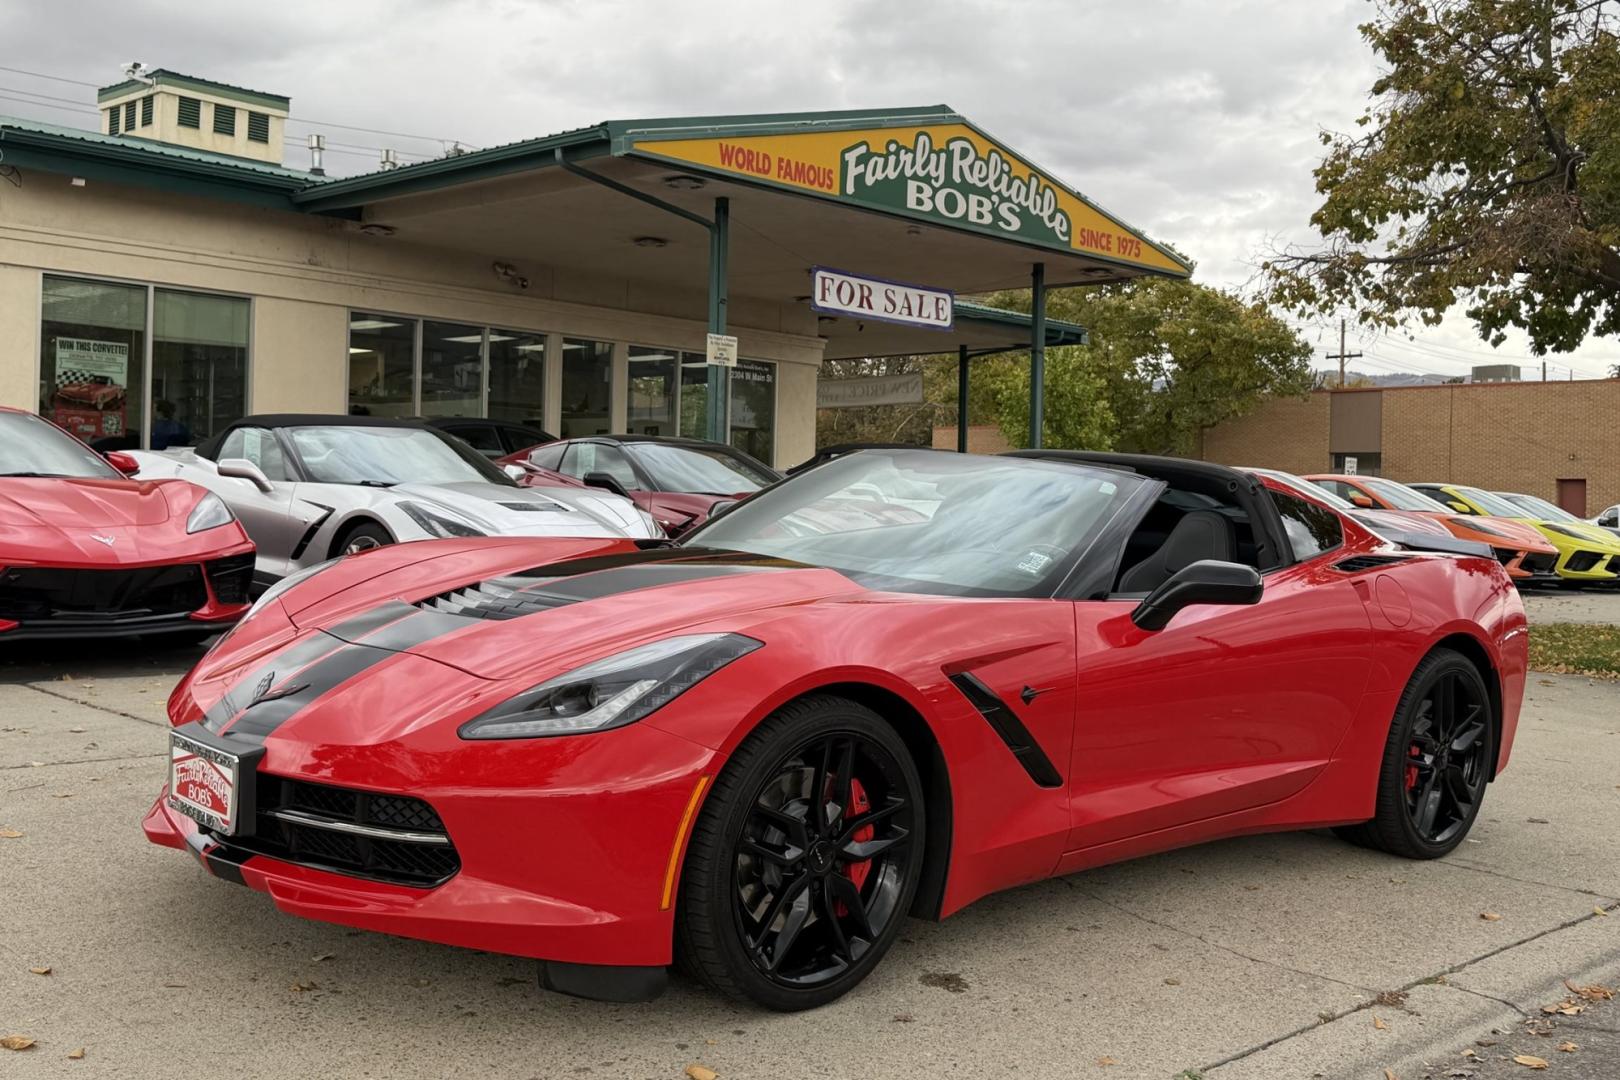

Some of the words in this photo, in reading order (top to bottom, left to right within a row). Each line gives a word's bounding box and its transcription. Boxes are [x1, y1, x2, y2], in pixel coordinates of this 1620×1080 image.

[719, 143, 771, 175] WORLD
[777, 157, 834, 190] FAMOUS
[845, 135, 946, 195] Fairly
[949, 140, 1069, 241] Reliable
[907, 180, 1022, 232] BOB'S
[1080, 228, 1112, 251] SINCE
[1117, 236, 1141, 257] 1975
[820, 276, 874, 310] FOR
[884, 288, 948, 321] SALE
[59, 340, 74, 350] WIN
[76, 341, 91, 351] THIS
[92, 343, 128, 355] CORVETTE!
[188, 783, 212, 808] BOB'S
